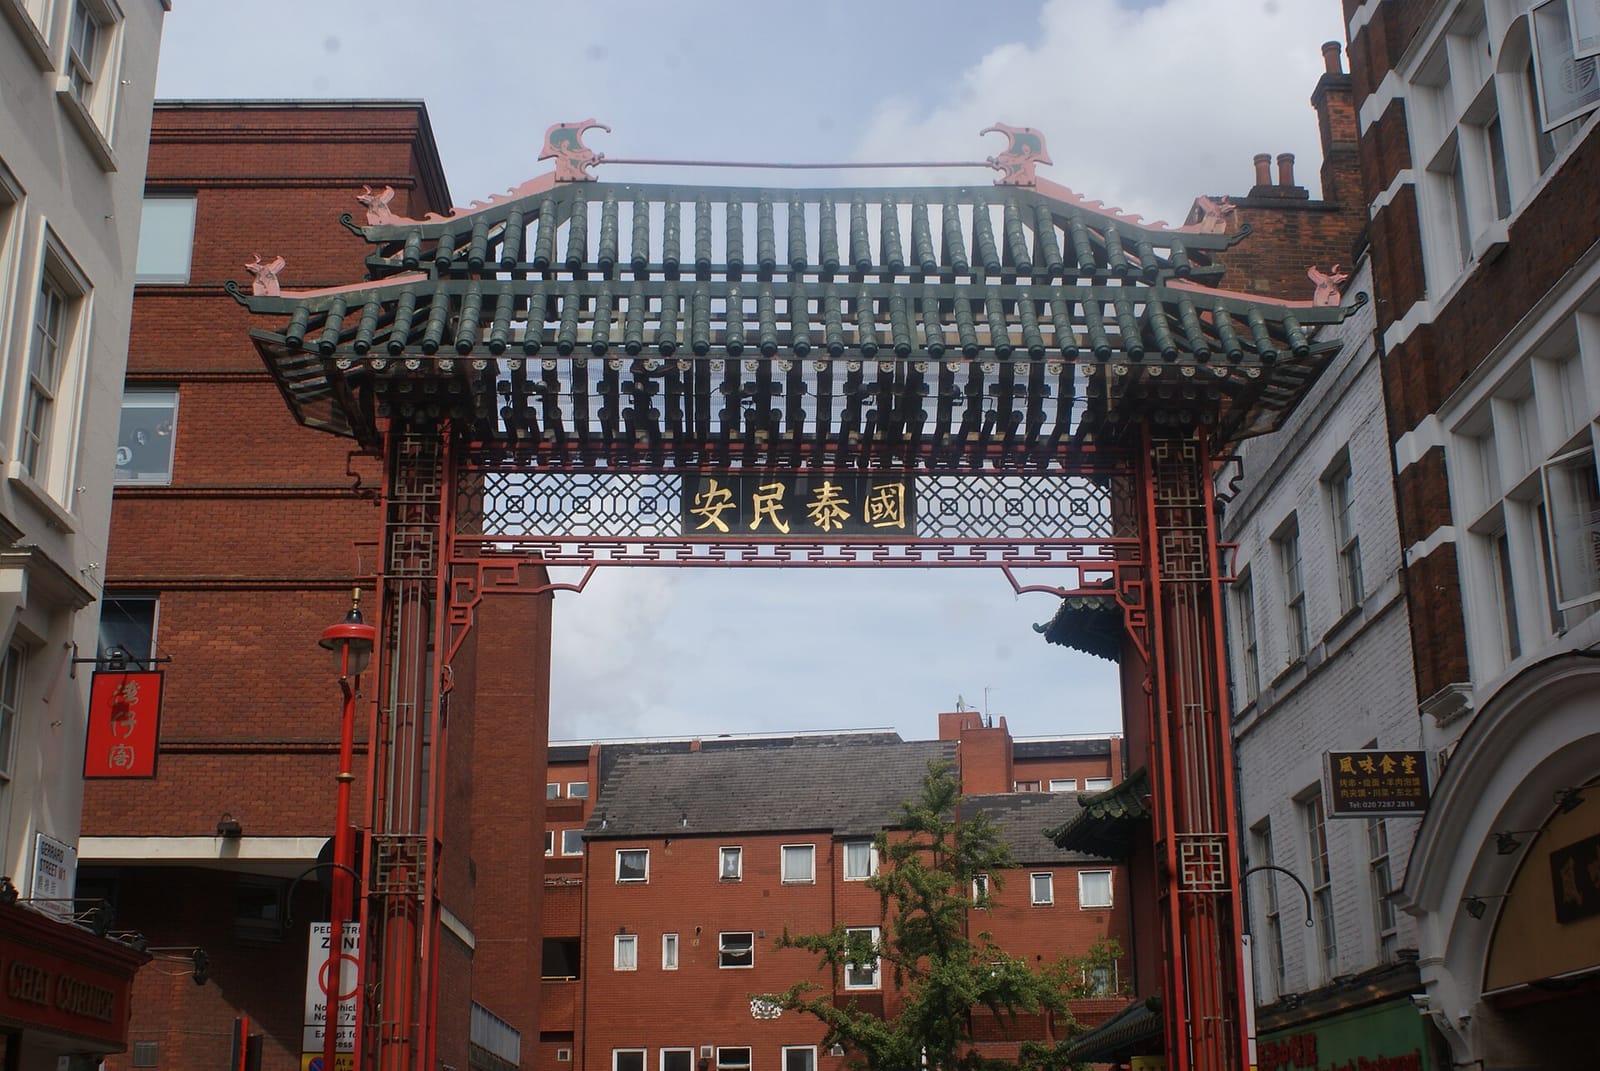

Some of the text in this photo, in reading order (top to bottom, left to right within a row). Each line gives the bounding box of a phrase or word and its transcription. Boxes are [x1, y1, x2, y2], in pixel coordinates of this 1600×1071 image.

[1338, 754, 1417, 775] 風味食堂
[1348, 801, 1361, 809] Tel:
[1362, 801, 1377, 809] 020
[40, 858, 57, 877] STREET
[321, 937, 360, 949] ZN
[8, 960, 49, 1006] CHAI
[314, 1003, 327, 1011] No
[315, 1030, 346, 1039] Expt
